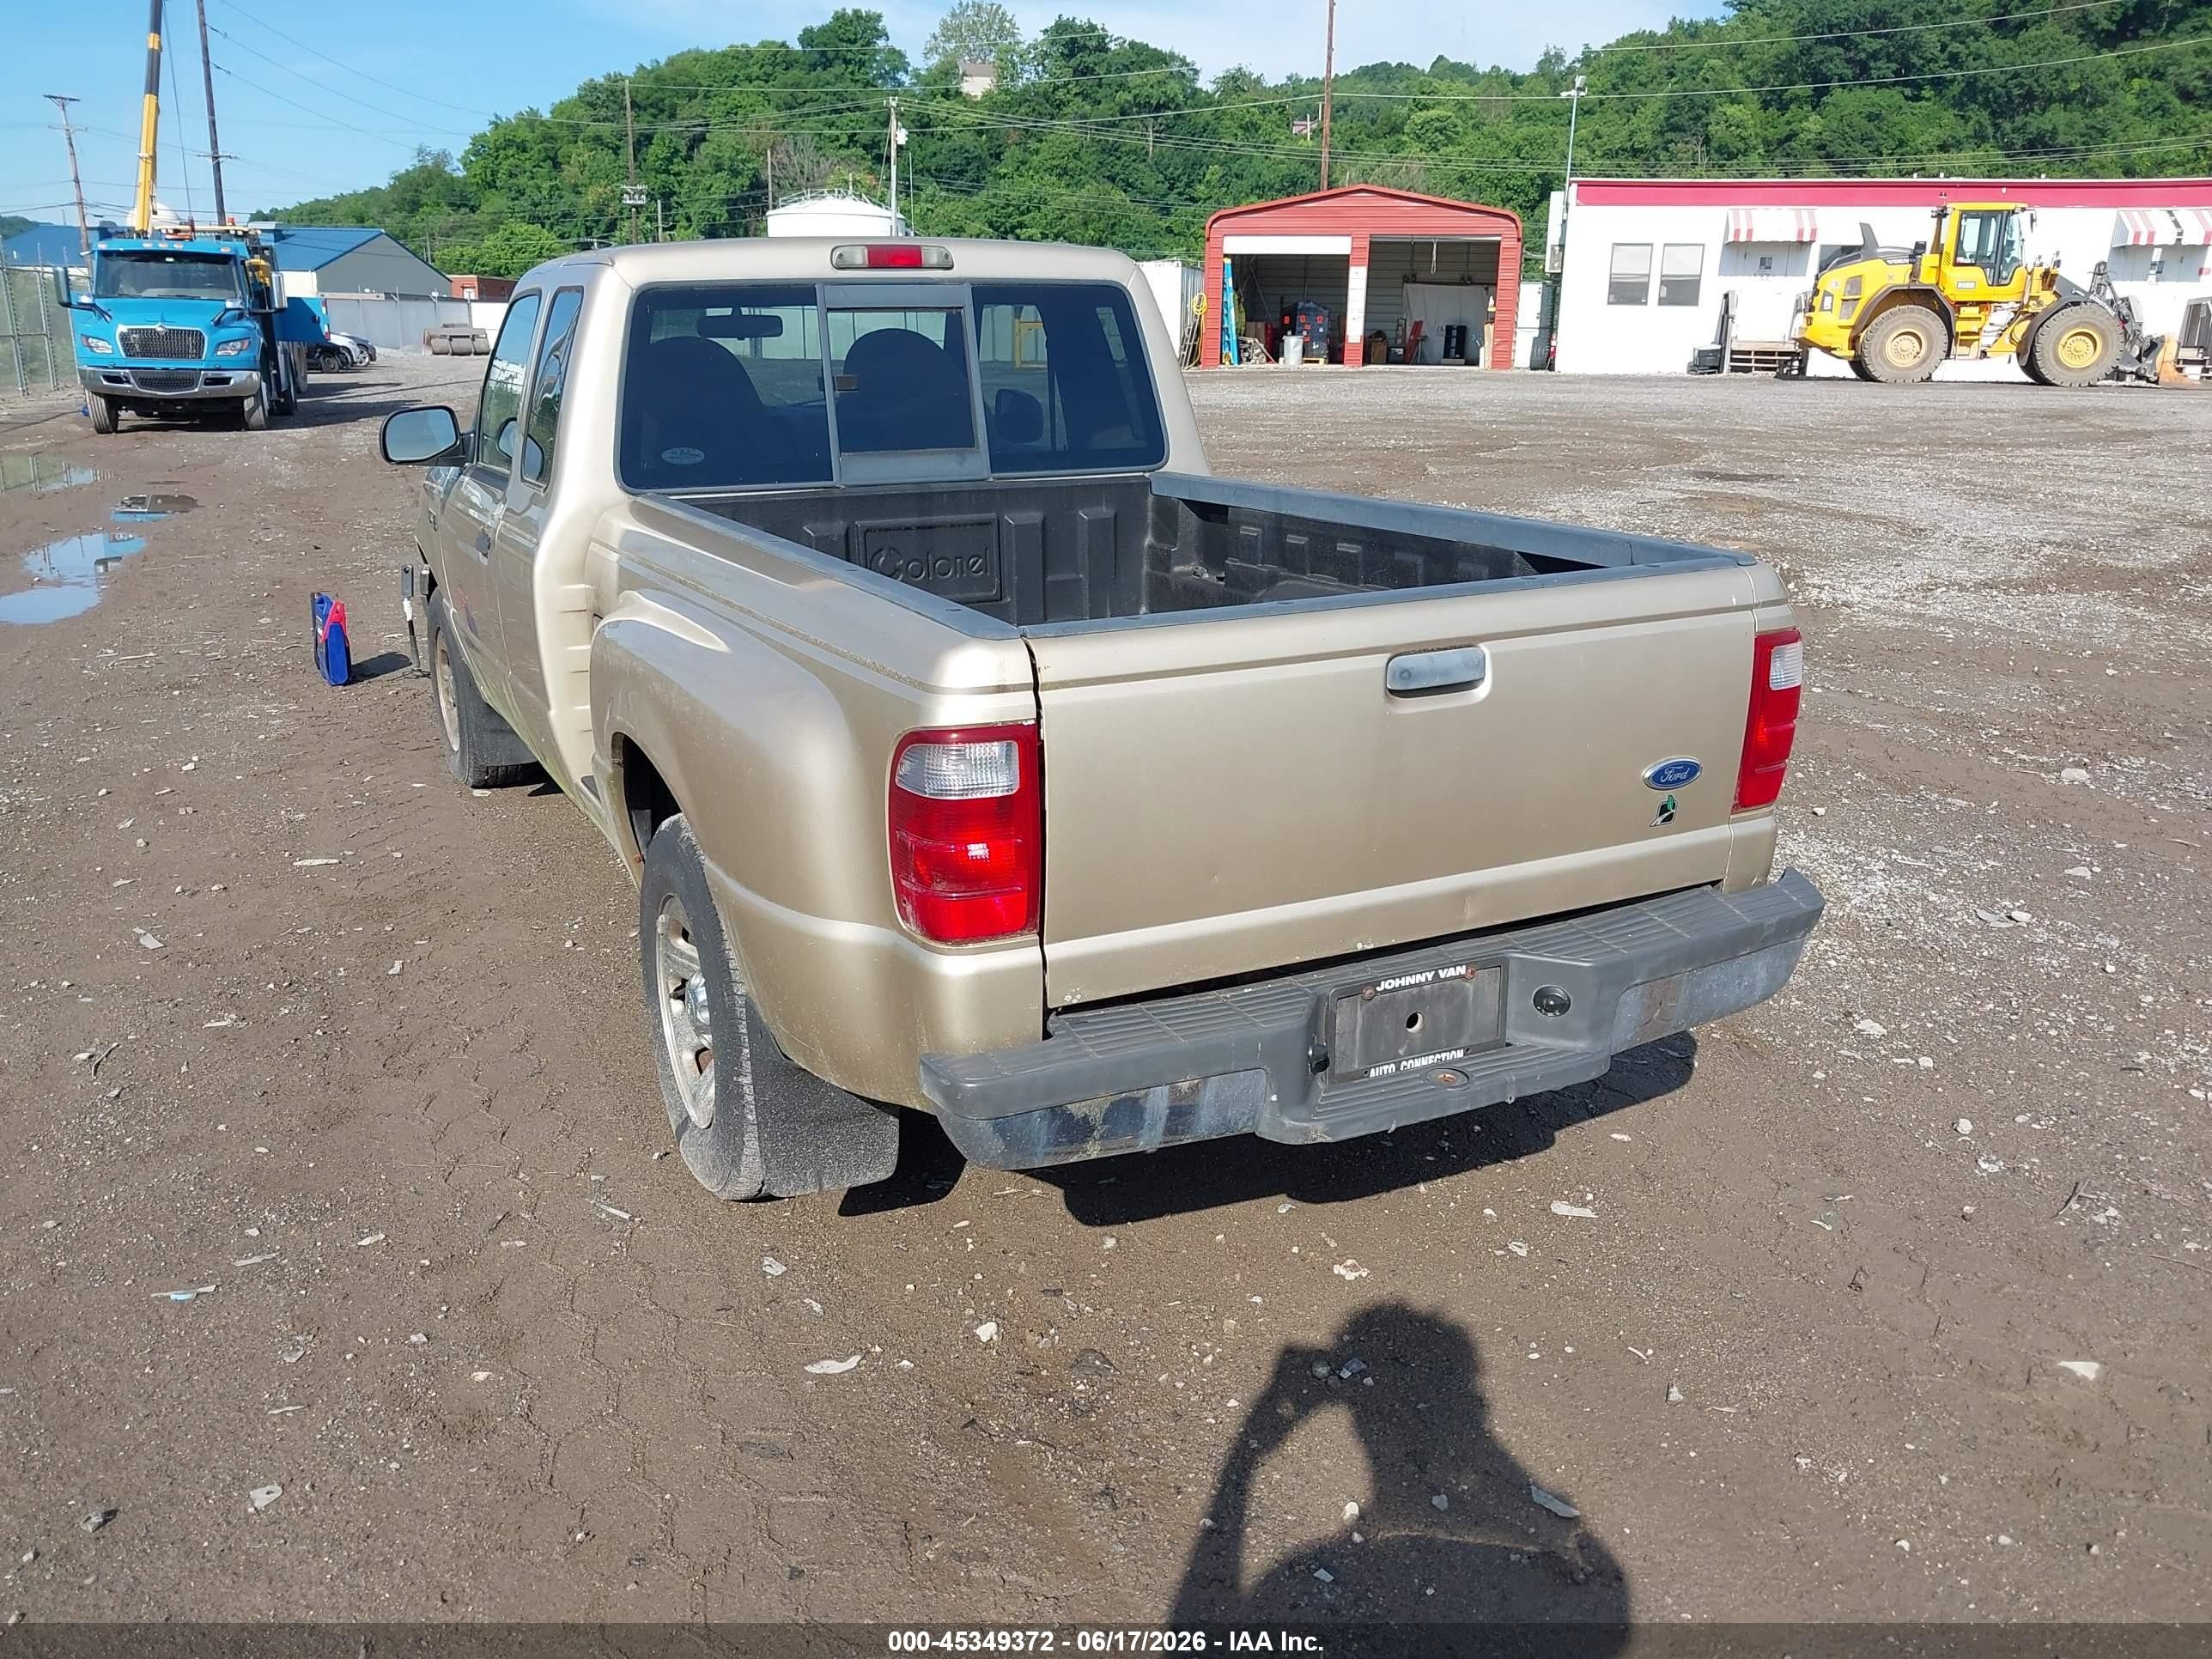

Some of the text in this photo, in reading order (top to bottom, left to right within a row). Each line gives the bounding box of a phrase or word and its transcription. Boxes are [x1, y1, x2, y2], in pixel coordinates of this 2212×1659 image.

[870, 547, 991, 581] Colonel
[1660, 765, 1691, 783] Ford
[1376, 964, 1468, 992] JOHNNY VAN
[1369, 1048, 1464, 1078] AUTO CONNECTION
